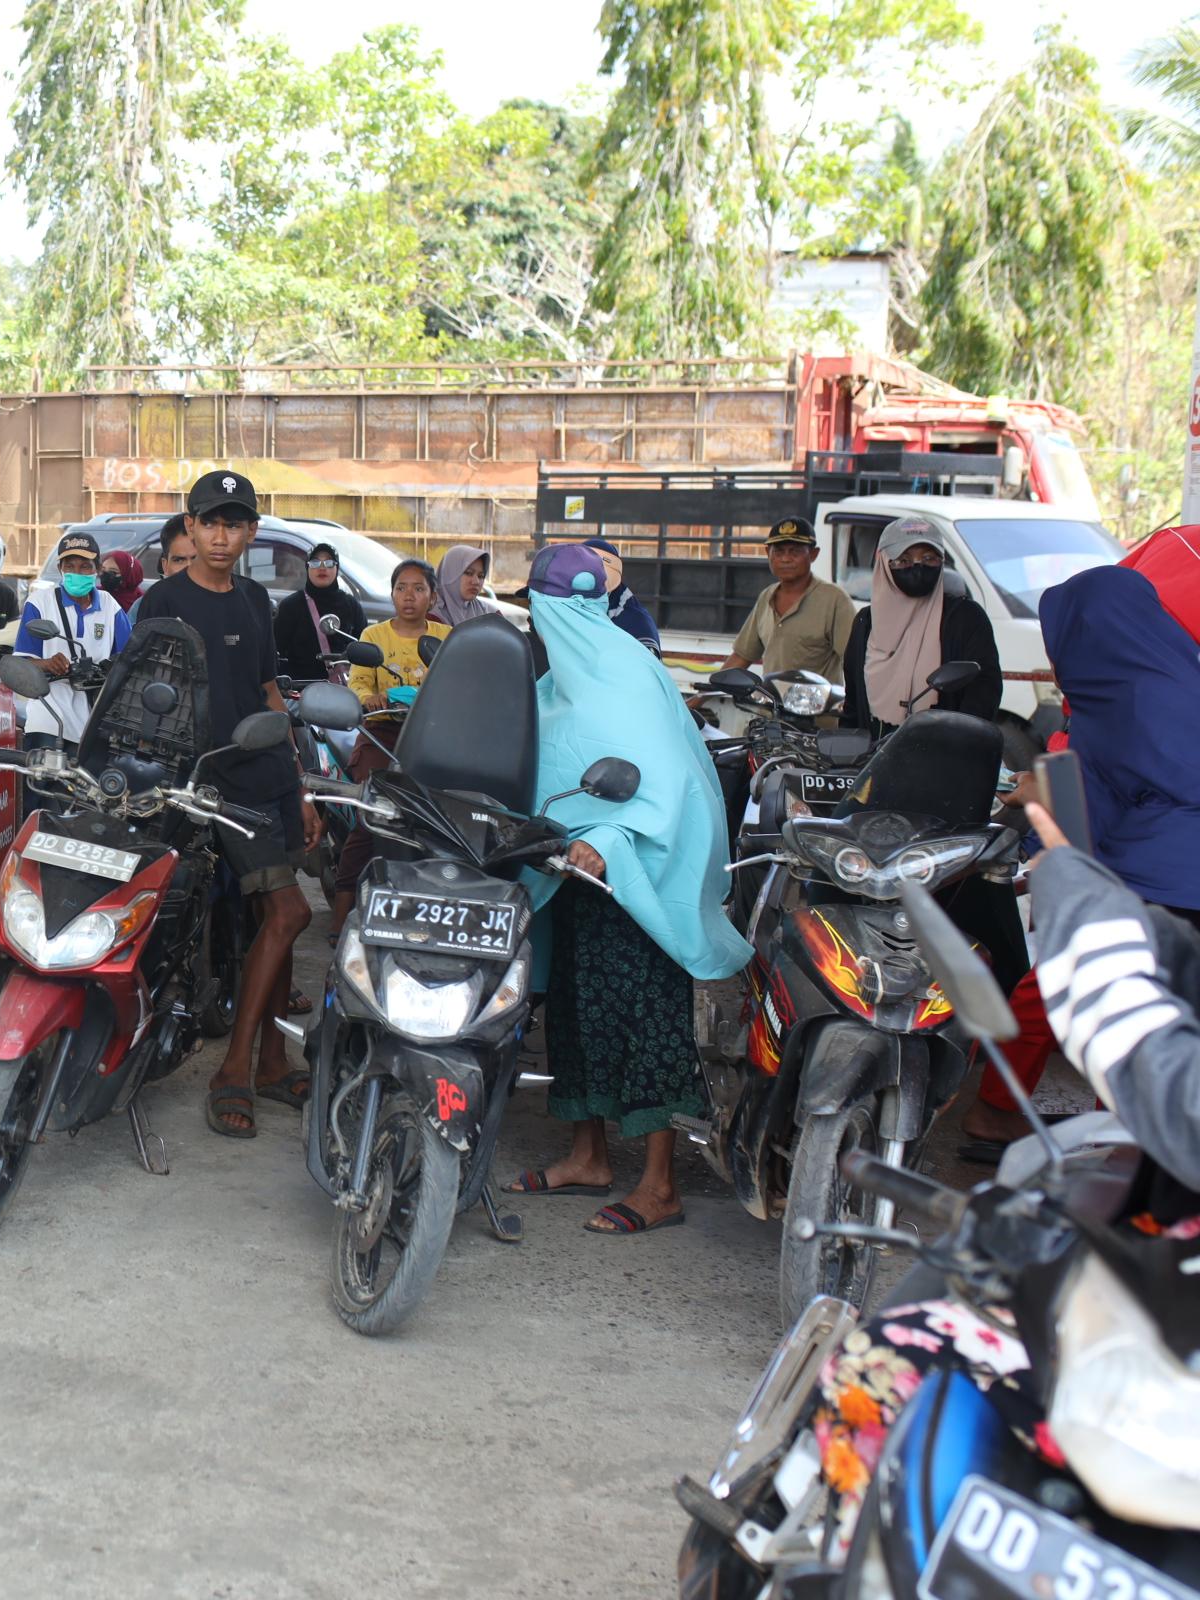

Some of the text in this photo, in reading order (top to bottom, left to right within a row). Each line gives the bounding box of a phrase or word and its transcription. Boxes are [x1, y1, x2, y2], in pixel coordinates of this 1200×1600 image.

[805, 776, 855, 789] DD 39
[30, 833, 138, 868] DD 6252 W
[373, 898, 403, 919] KT
[414, 903, 469, 926] 2927
[481, 911, 510, 931] JK
[954, 1491, 1040, 1573] DD
